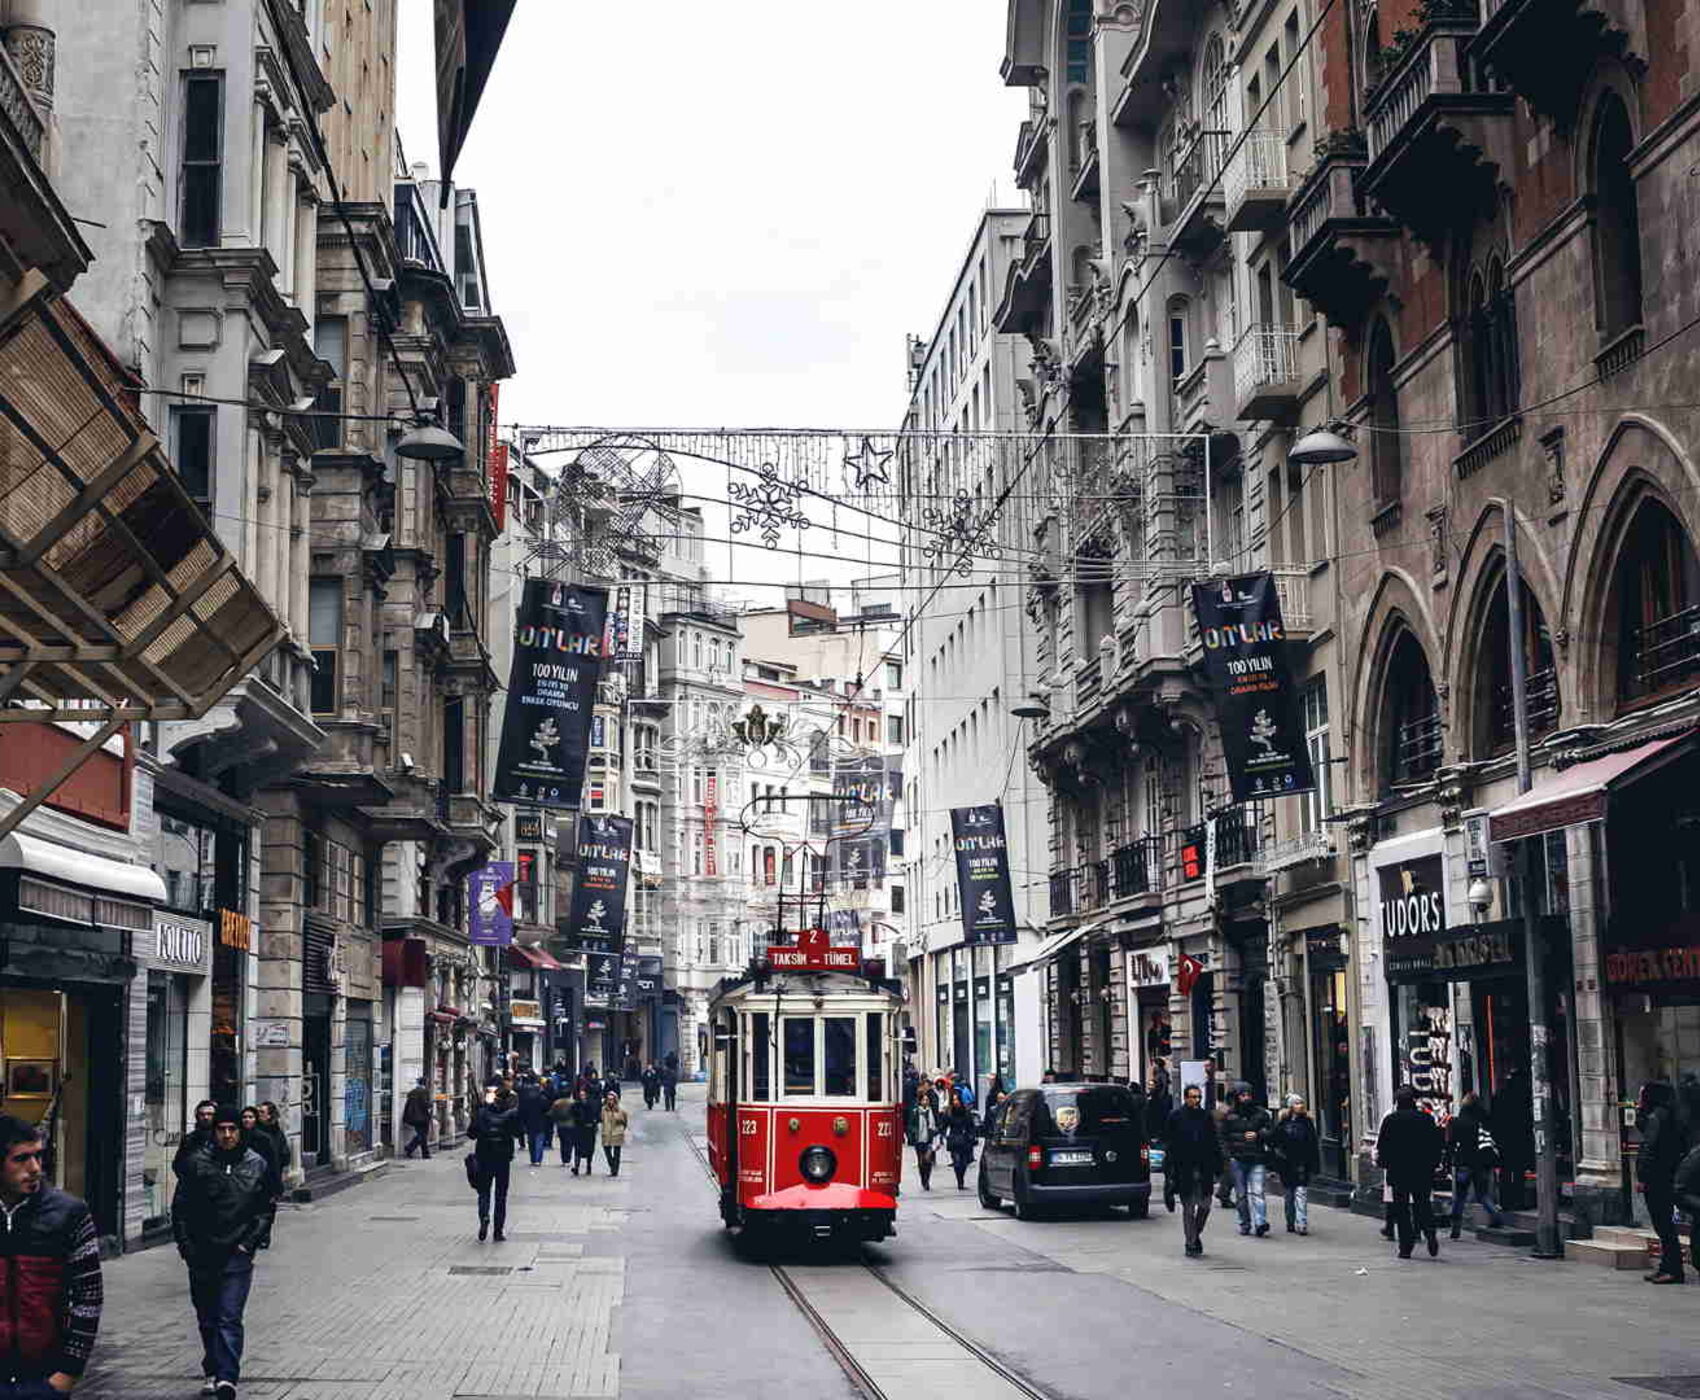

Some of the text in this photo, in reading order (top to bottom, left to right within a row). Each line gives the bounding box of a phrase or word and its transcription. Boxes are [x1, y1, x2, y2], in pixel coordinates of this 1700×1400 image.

[532, 663, 551, 678] 100
[1227, 659, 1247, 675] 100
[1378, 891, 1441, 938] TUDORS
[809, 929, 818, 944] 2
